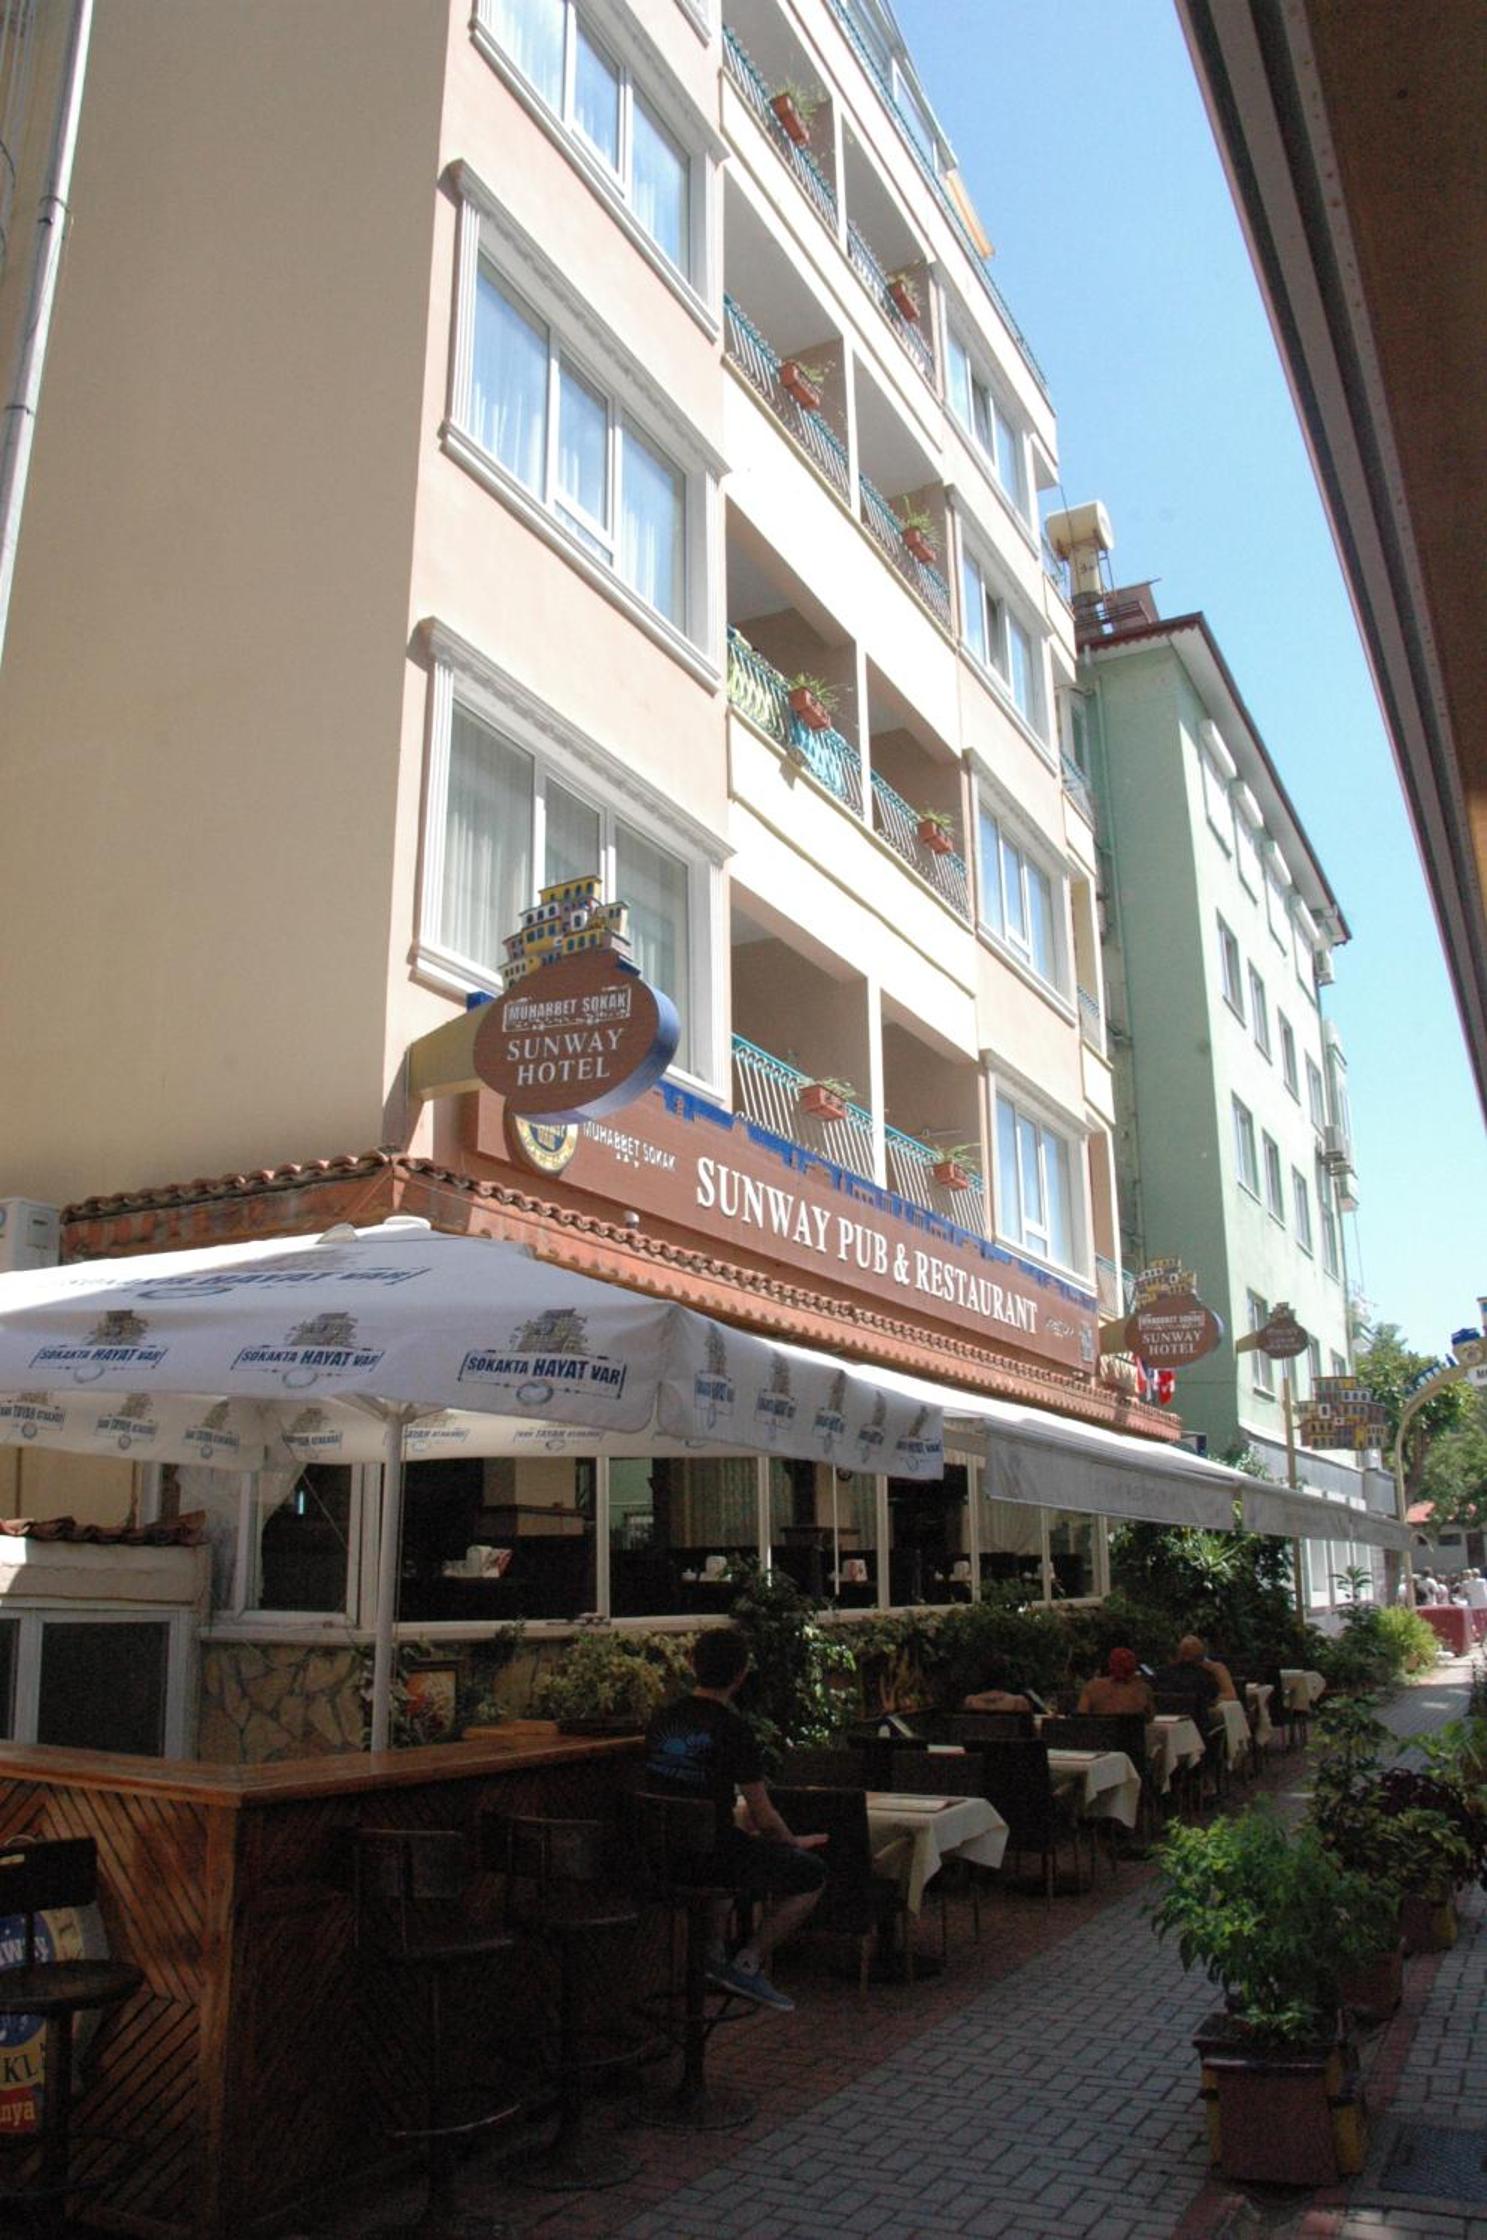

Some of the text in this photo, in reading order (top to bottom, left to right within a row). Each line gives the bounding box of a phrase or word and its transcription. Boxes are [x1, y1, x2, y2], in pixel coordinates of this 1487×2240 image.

[582, 991, 627, 1014] SOKAK
[506, 1027, 624, 1061] SUNWAY
[517, 1057, 610, 1086] HOTEL
[583, 1120, 641, 1158] MUHABBET
[696, 1156, 1039, 1335] SUNWAY PUB & RESTAURANT
[1142, 1329, 1202, 1345] SUNWAY
[1149, 1342, 1196, 1357] HOTEL
[90, 1348, 140, 1361] HAYAT
[241, 1350, 299, 1363] SOKAKTA
[299, 1350, 354, 1367] HAYAT
[467, 1356, 622, 1386] SOKAKTA HAYAT VAR
